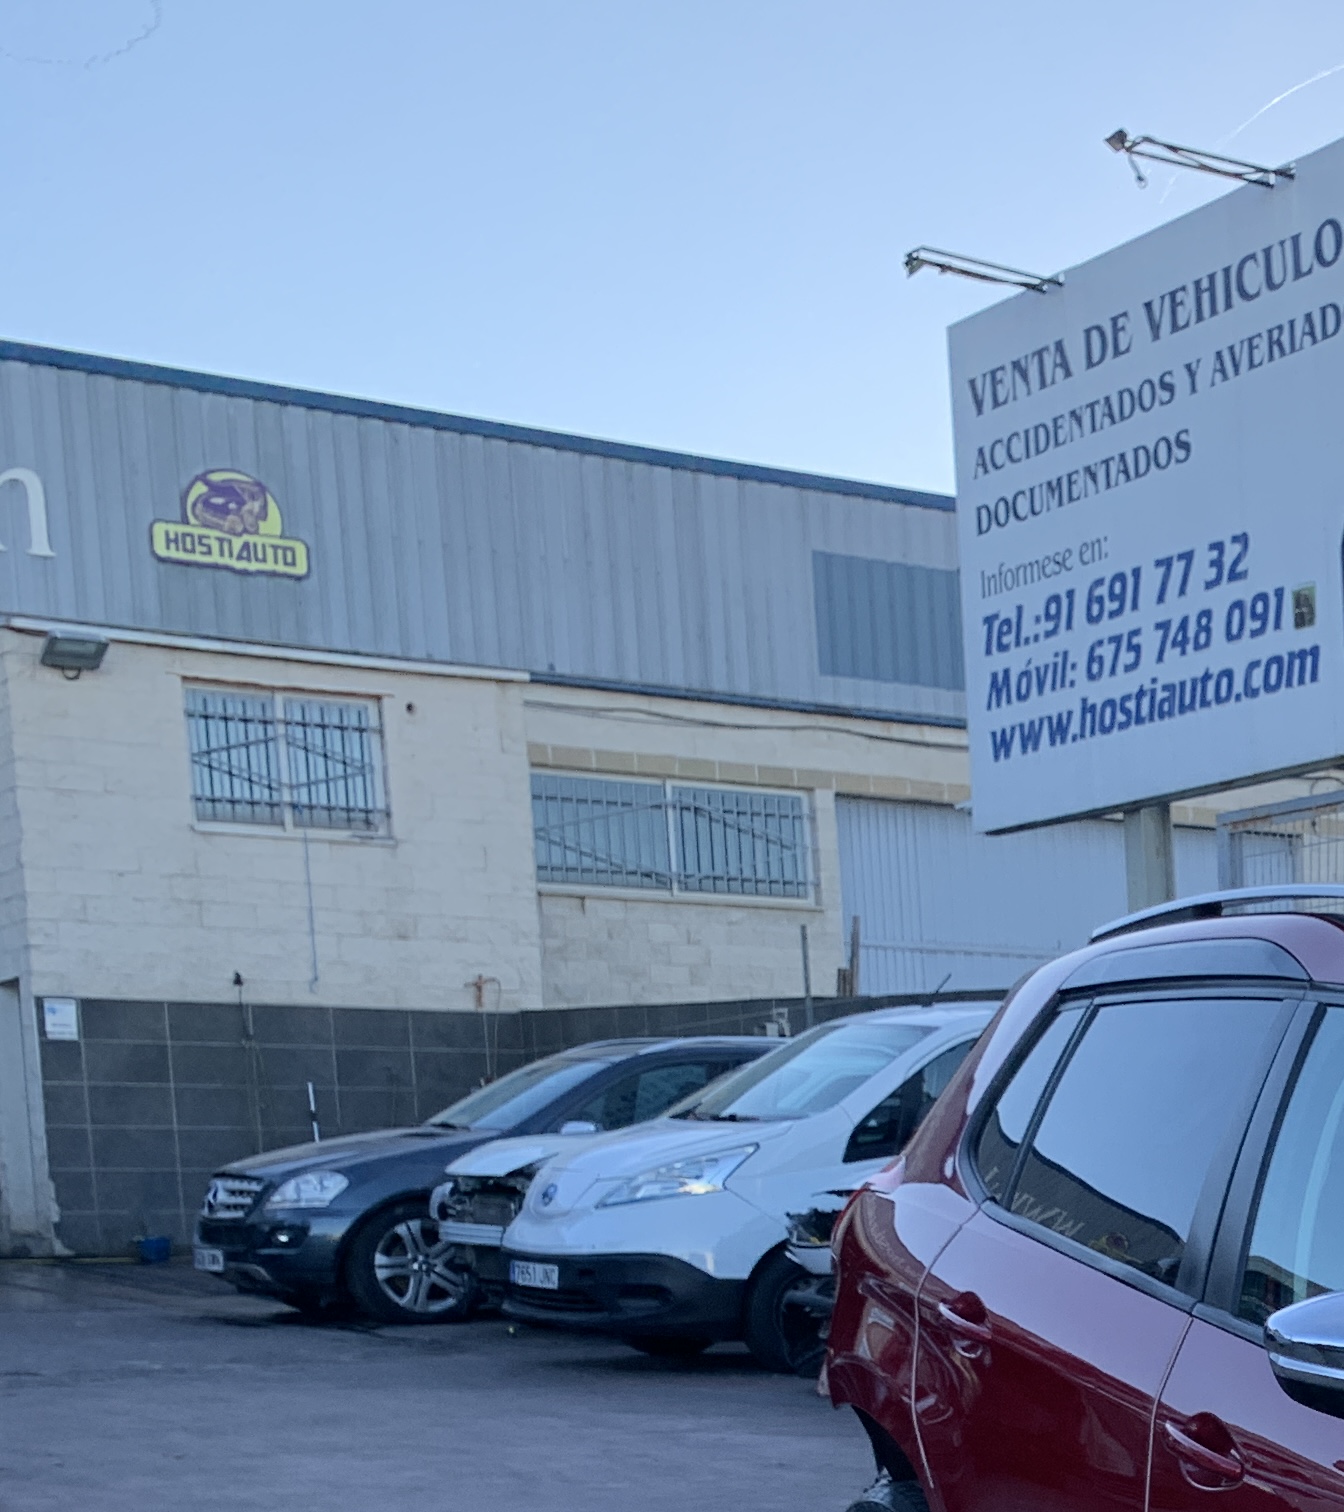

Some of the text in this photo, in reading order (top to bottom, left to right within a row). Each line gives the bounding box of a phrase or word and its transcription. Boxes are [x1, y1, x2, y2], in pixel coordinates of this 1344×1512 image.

[968, 338, 1073, 418] VENTA
[1083, 311, 1134, 372] DE
[973, 369, 1176, 480] ACCIDENTADOS
[1184, 357, 1202, 396] Y
[975, 428, 1192, 536] DOCUMENTADOS
[164, 529, 297, 568] HOSTIAUTO
[980, 536, 1109, 599] Informese en:
[1086, 566, 1142, 627] 691
[1154, 549, 1195, 604] 77
[1204, 531, 1249, 591] 32
[986, 586, 1285, 711] Móvil: 675 748 091
[990, 644, 1321, 763] www.hostiauto.com
